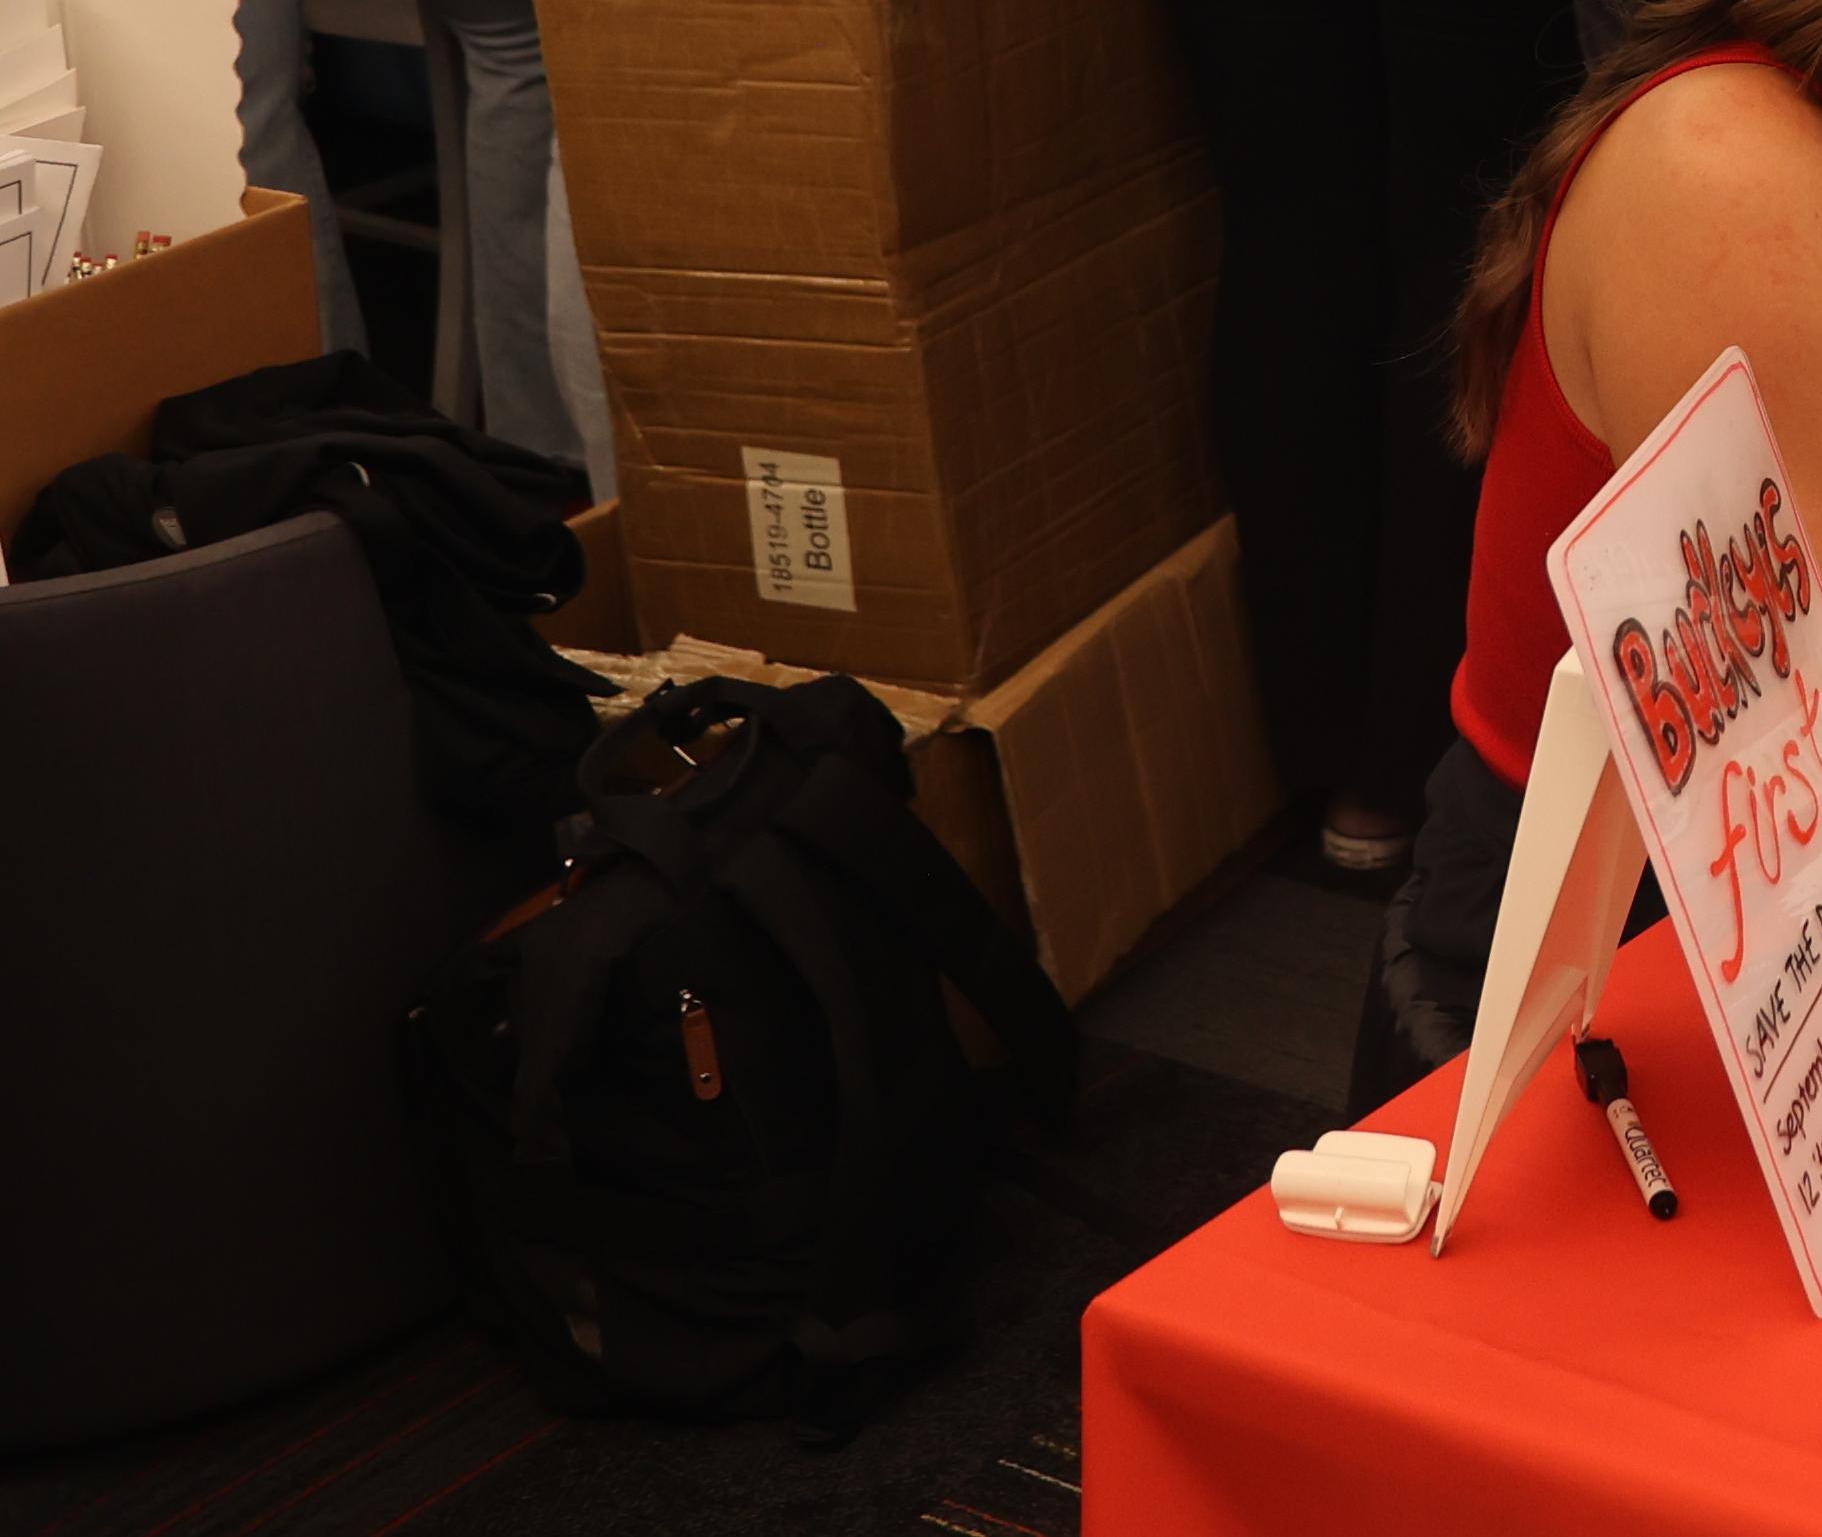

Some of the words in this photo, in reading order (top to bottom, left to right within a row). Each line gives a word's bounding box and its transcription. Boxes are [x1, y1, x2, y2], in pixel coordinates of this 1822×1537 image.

[801, 488, 833, 572] Bottle
[1613, 478, 1811, 795] Buckeyes
[1745, 976, 1791, 1079] SAVE
[1785, 920, 1820, 993] THE
